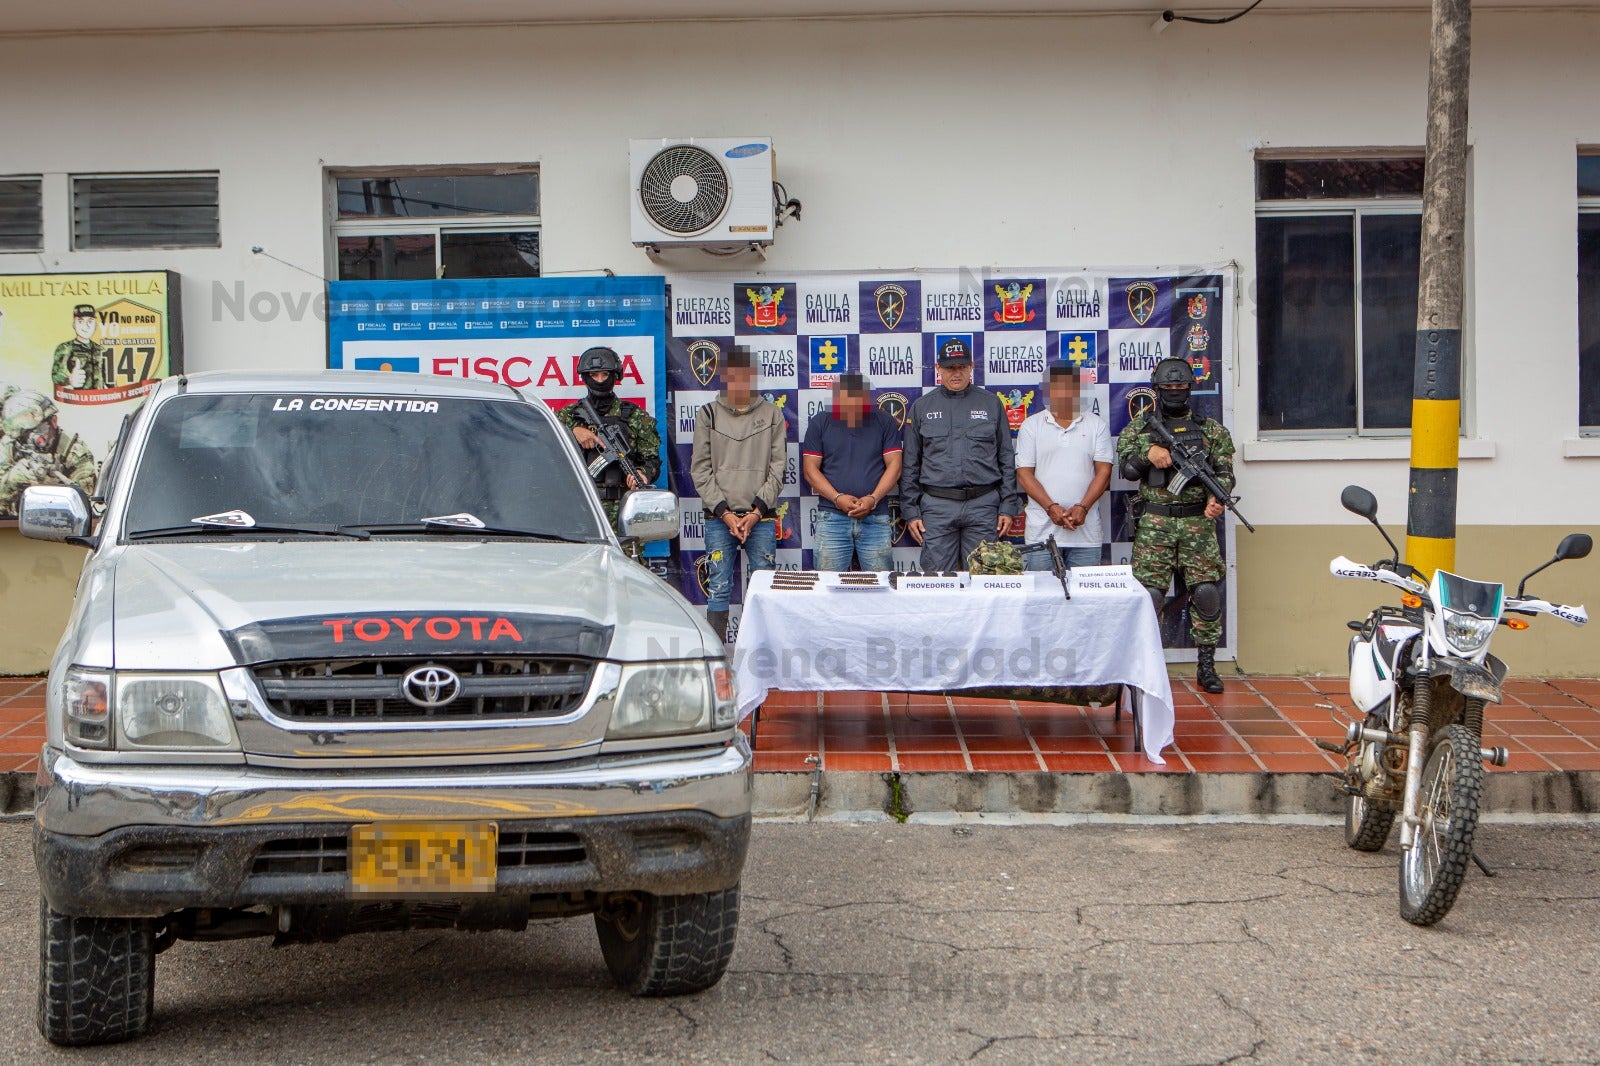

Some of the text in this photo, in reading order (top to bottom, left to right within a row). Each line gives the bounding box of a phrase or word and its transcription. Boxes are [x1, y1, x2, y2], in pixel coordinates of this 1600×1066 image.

[1, 279, 163, 297] MILITAR HUILA
[676, 297, 730, 311] FUERZAS
[806, 294, 850, 309] GAULA
[927, 293, 980, 308] FUERZAS
[1056, 290, 1100, 304] GAULA
[98, 311, 156, 325] YO NO PAGO
[676, 311, 731, 325] MILITARES
[806, 309, 850, 323] MILITAR
[926, 308, 981, 321] MILITARES
[1056, 304, 1100, 318] MILITAR
[869, 346, 913, 361] GAULA
[945, 344, 964, 353] CTI
[990, 346, 1043, 360] FUERZAS
[1120, 342, 1162, 357] GAULA
[758, 350, 793, 363] RZAS
[101, 347, 156, 384] 147
[432, 353, 645, 388] FISCALA
[762, 364, 794, 377] TARES
[870, 361, 913, 375] MILITAR
[989, 360, 1044, 374] MILITARES
[273, 399, 439, 413] LA CONSENTIDA
[926, 412, 943, 420] CTI
[322, 618, 523, 643] TOYOTA
